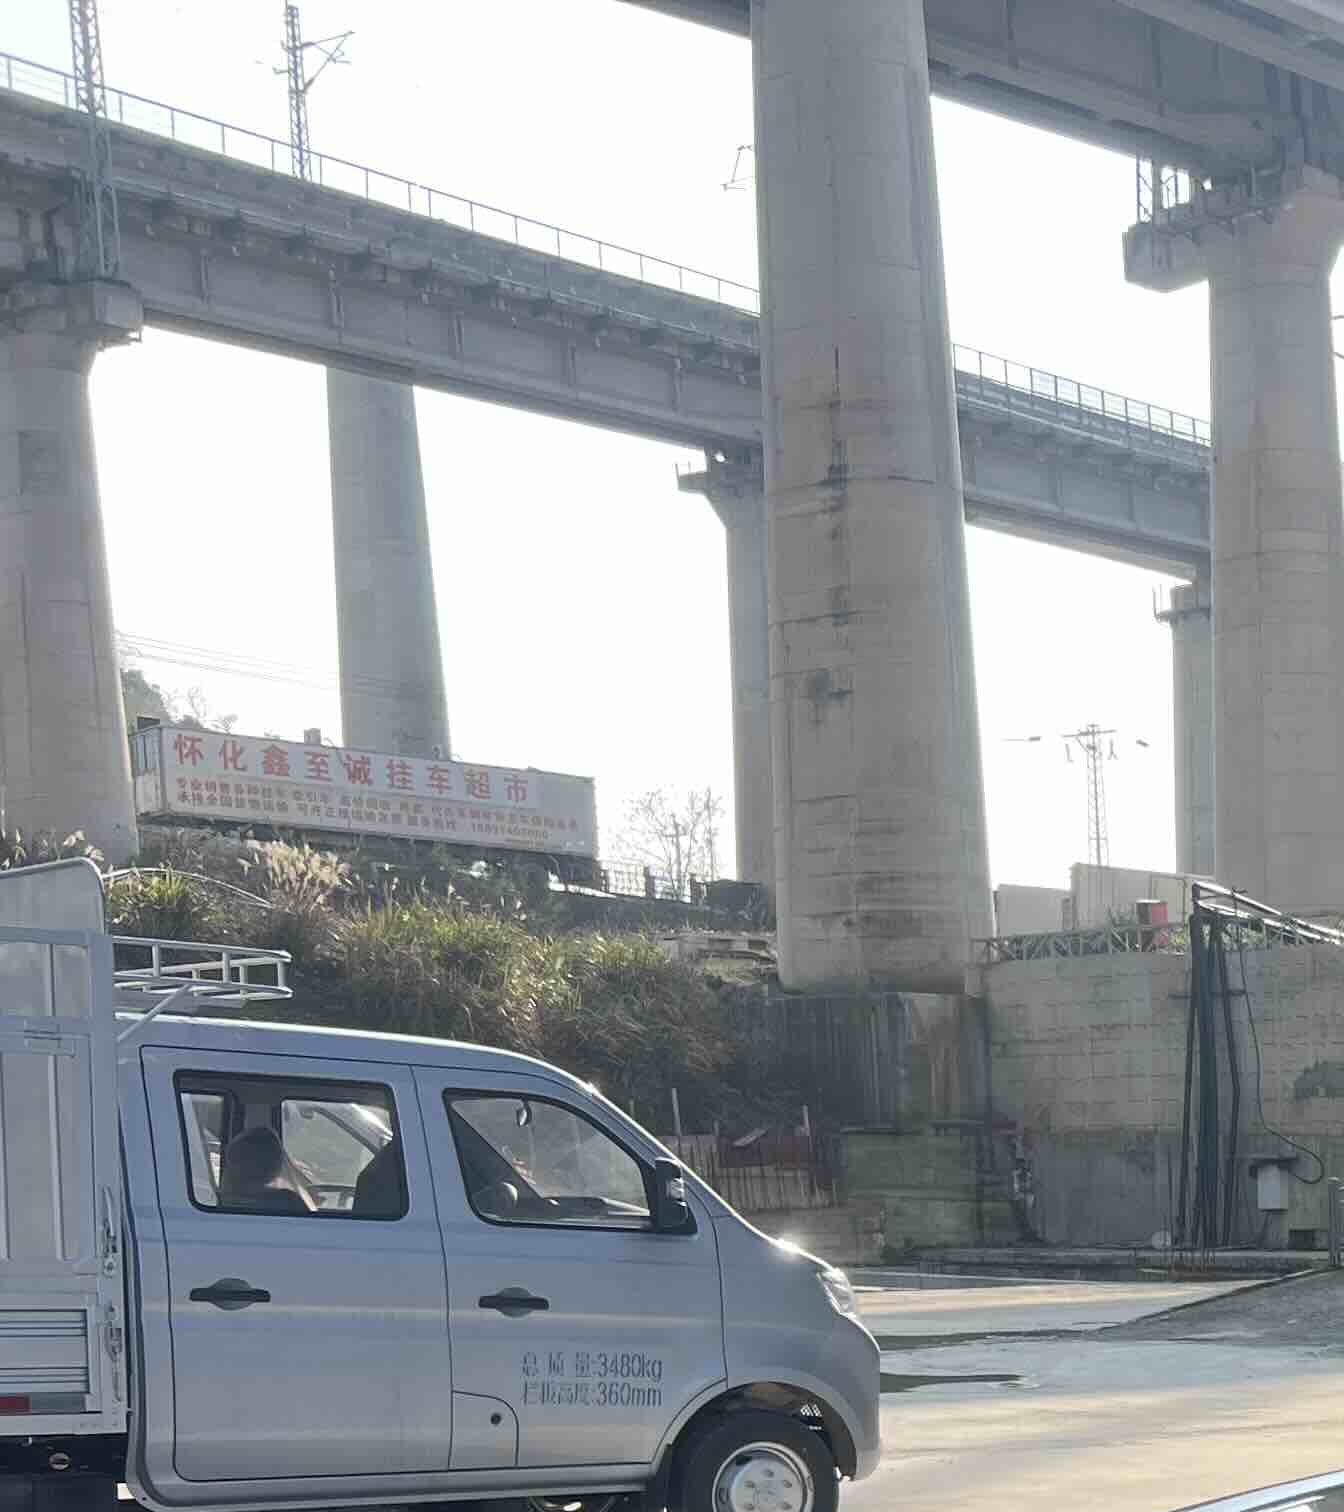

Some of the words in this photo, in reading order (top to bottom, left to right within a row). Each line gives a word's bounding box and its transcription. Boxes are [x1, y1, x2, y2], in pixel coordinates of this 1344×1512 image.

[173, 735, 530, 802] 怀化鑫至诚挂车超市
